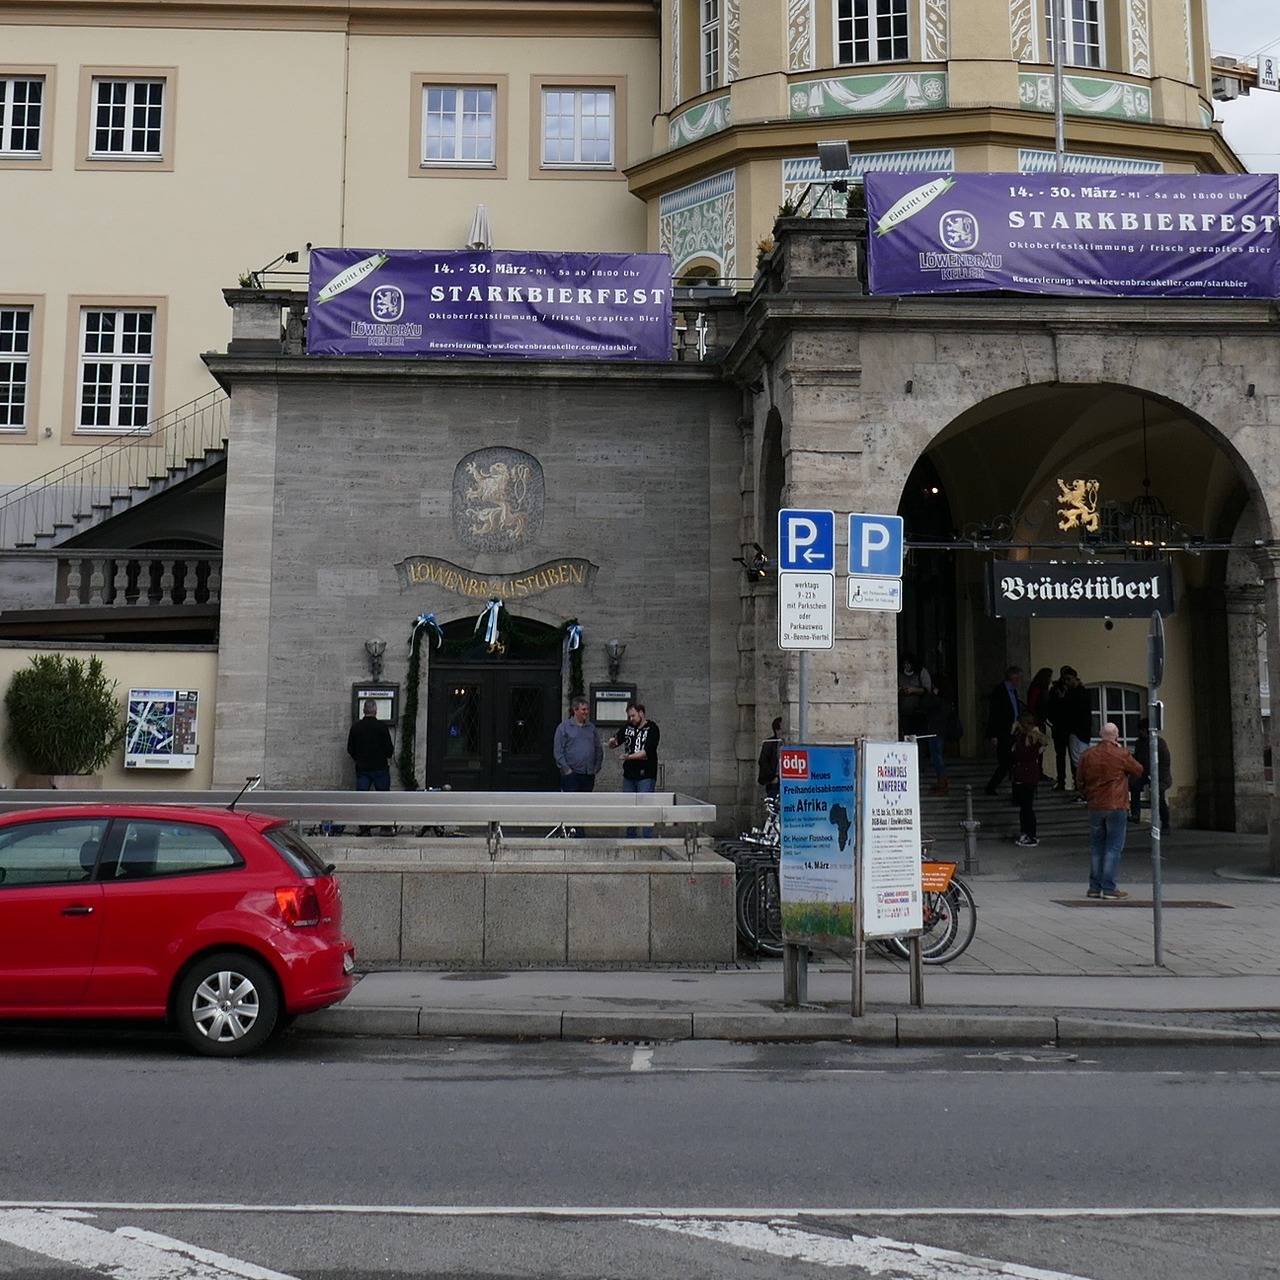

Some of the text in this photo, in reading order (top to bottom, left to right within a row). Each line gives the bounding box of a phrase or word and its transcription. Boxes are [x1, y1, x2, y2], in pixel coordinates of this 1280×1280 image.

[1009, 187, 1033, 199] 14.
[1051, 187, 1075, 199] 30.
[1081, 187, 1117, 199] März
[1155, 191, 1167, 199] Sa
[1173, 191, 1186, 200] ab
[1192, 192, 1223, 200] 18:00
[1229, 192, 1248, 200] Uhr
[889, 184, 938, 222] Eintritt frei
[1008, 211, 1275, 233] STARKBIERFEST
[1008, 241, 1135, 253] Oktoberfeststimmung
[1150, 243, 1183, 252] frisch
[1189, 245, 1244, 254] gezapftes
[1249, 246, 1271, 254] Bier
[919, 252, 1003, 269] LÖWENBRÄU
[433, 263, 454, 274] 14.
[469, 263, 491, 274] 30.
[495, 263, 527, 275] März
[941, 269, 985, 280] KELLER
[328, 260, 374, 294] Eintritt frei
[1012, 276, 1248, 288] Reservierung: www.loewenbraeukeller.com/starkbier
[430, 285, 665, 305] STARKBIERFEST
[429, 312, 538, 322] Oktoberfeststimmung
[551, 313, 581, 322] frisch
[585, 314, 634, 323] gezapftes
[639, 314, 660, 322] Bier
[351, 321, 423, 337] LÖWENBRÄU
[368, 336, 405, 347] KELLER
[429, 341, 638, 352] Reservierung: www.loewenbraeukeller.com/starkbier
[788, 517, 818, 563] P
[861, 522, 891, 568] P
[409, 562, 584, 599] LÖWENBRÄUSTUBEN
[794, 581, 820, 590] werktags
[1000, 575, 1161, 601] Bräustüberl
[798, 612, 812, 620] oder
[789, 622, 823, 630] Parkausweis
[783, 633, 830, 641] St.-Benno-Viertel
[783, 754, 806, 774] ödp
[810, 771, 831, 780] Neues
[783, 784, 854, 795] Freihandelsabkommen
[877, 780, 908, 792] KONFERENZ
[783, 798, 828, 813] mit Afrika
[804, 861, 814, 870] 14.
[814, 861, 830, 870] März
